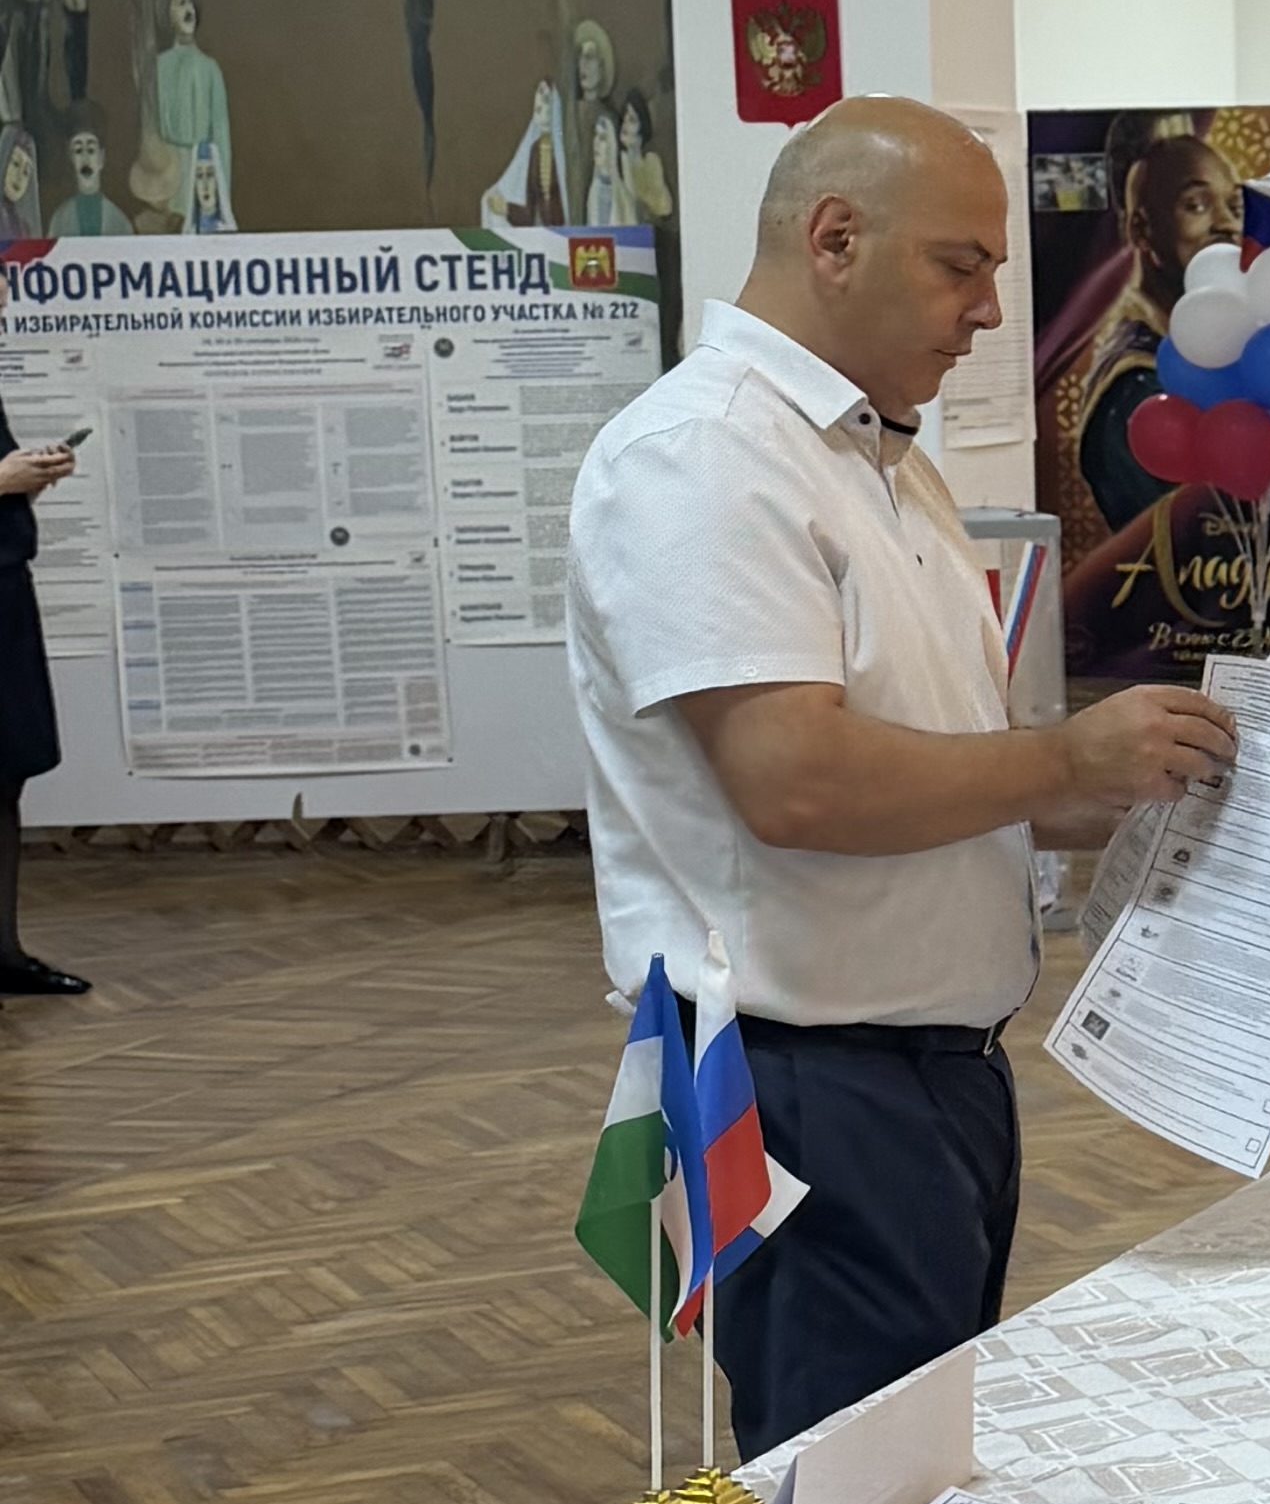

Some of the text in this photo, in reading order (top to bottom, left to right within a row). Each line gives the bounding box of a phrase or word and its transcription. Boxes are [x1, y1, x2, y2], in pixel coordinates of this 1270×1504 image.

[414, 252, 551, 296] СТЕНД
[14, 307, 184, 334] ИЗБИРАТЕЛЬНОЙ
[189, 308, 302, 330] КОМИССИИ
[308, 304, 486, 327] ИЗБИРАТЕЛЬНОГО
[491, 302, 578, 322] УЧАСТКА
[582, 303, 605, 321] №
[608, 300, 639, 320] 212
